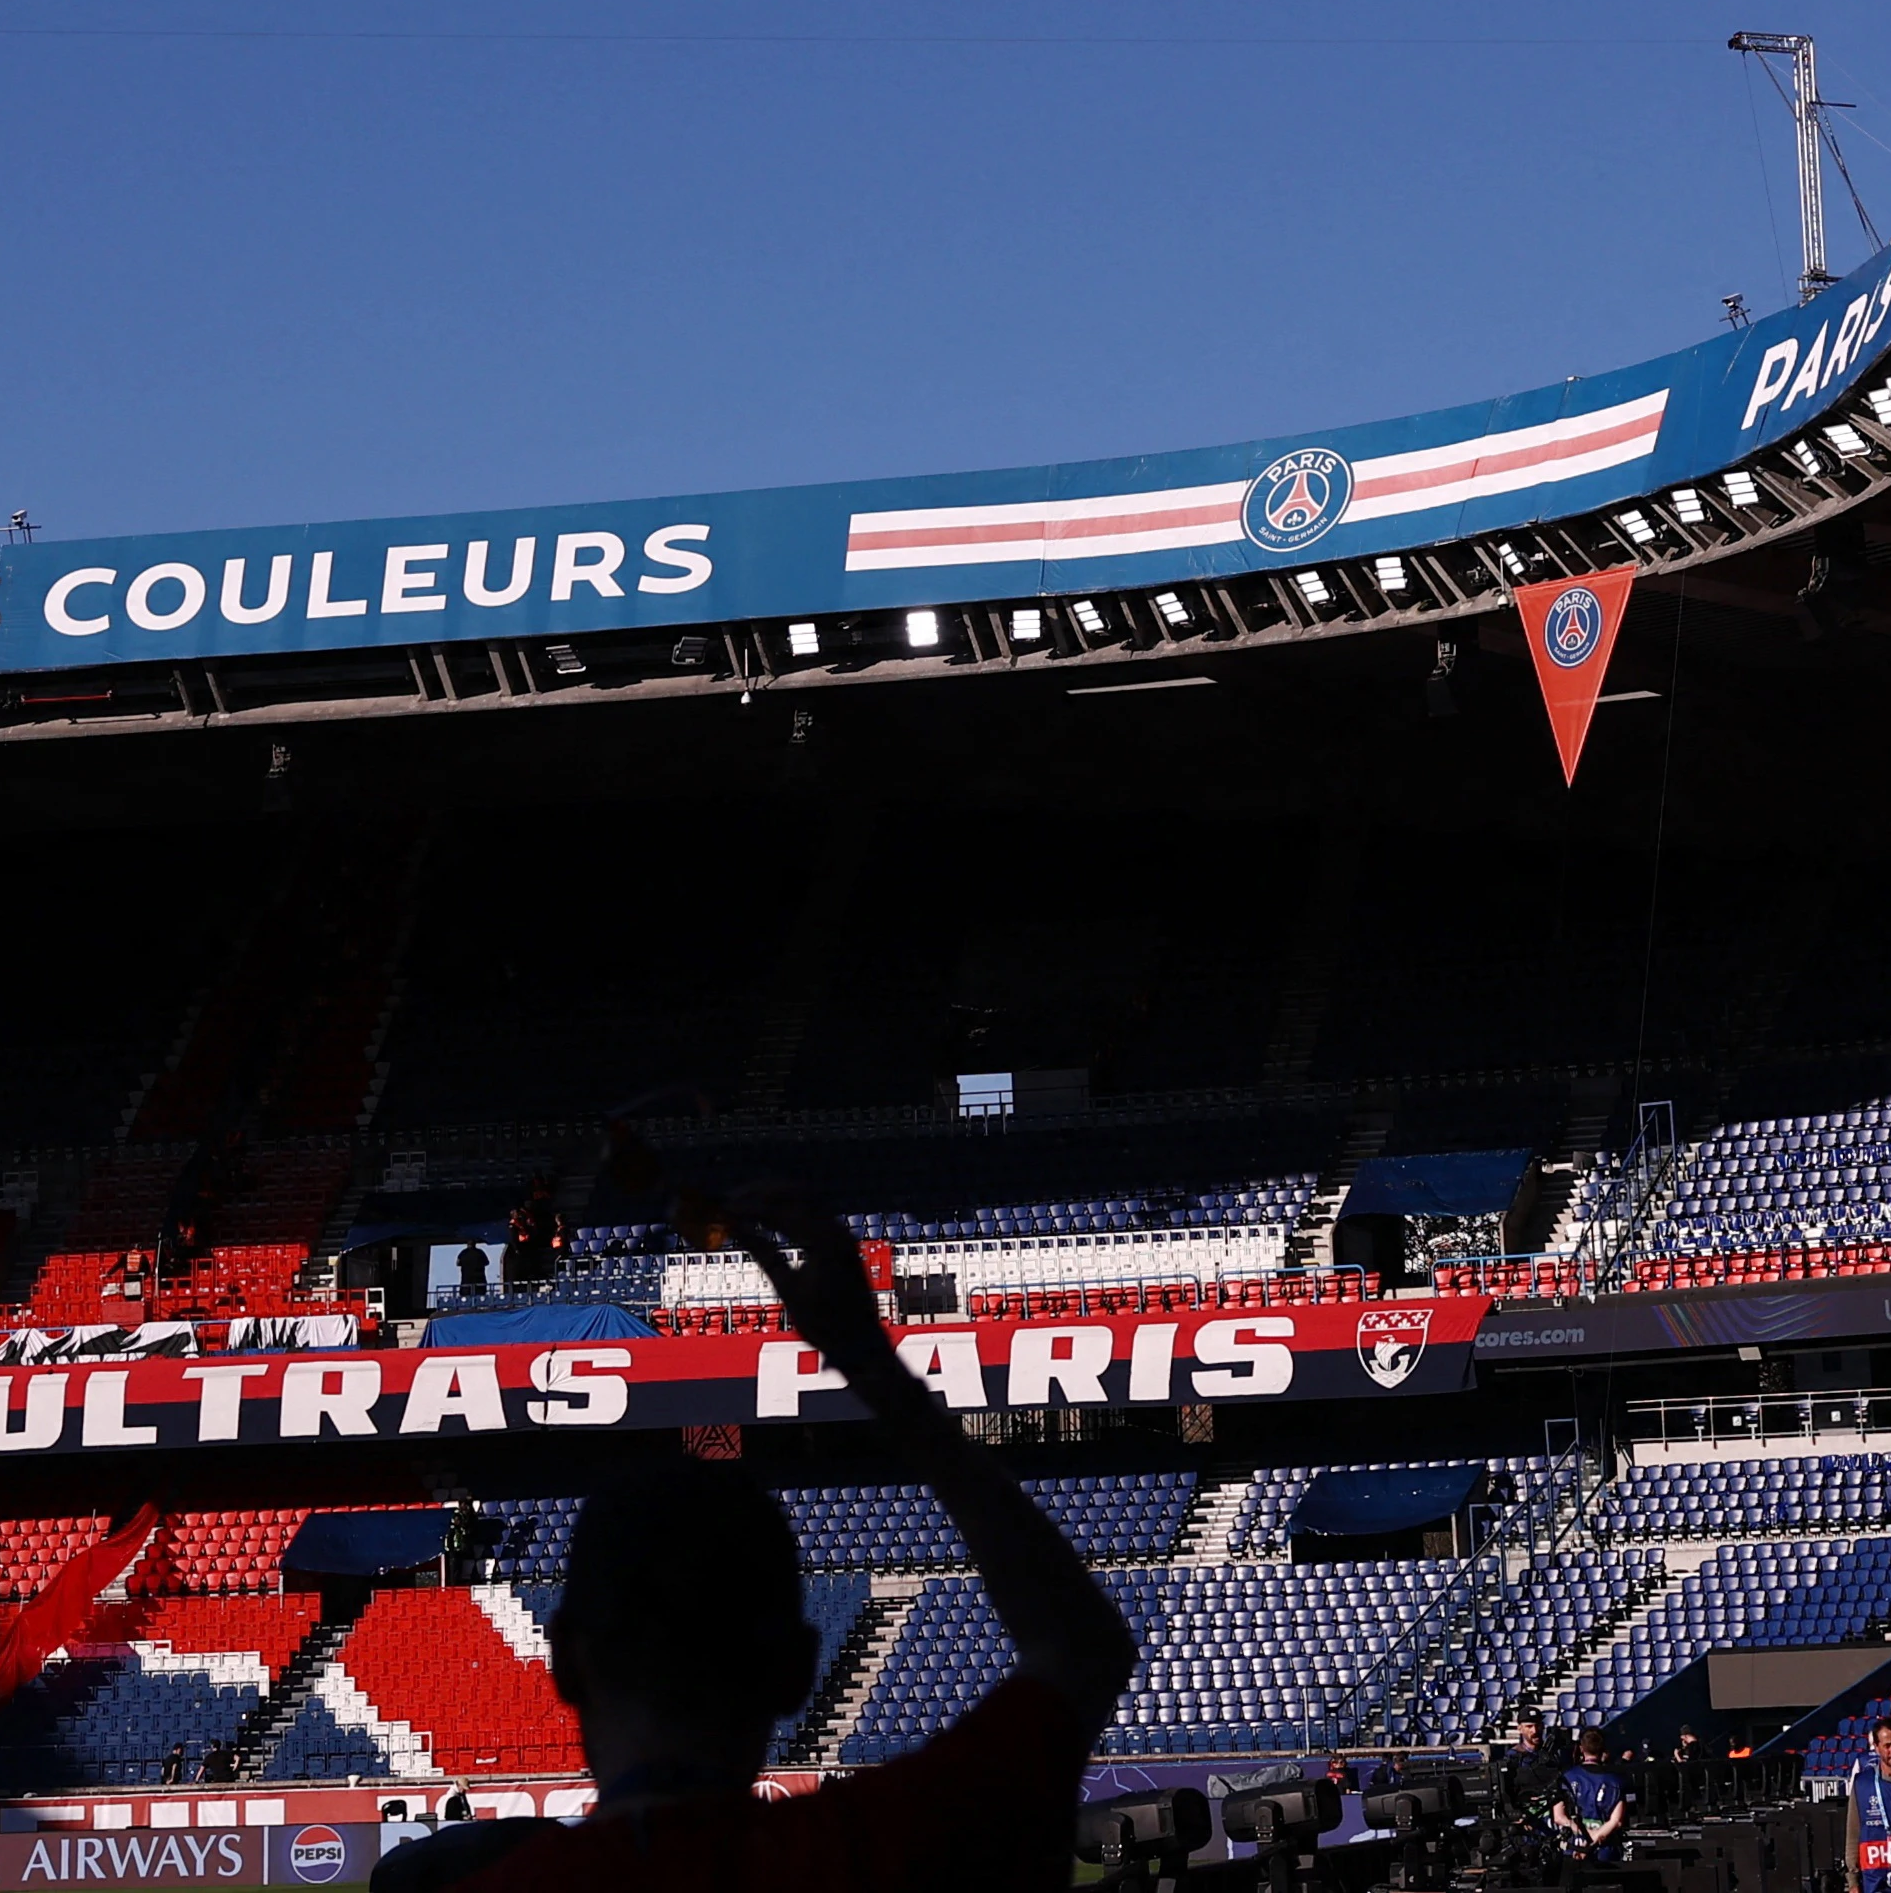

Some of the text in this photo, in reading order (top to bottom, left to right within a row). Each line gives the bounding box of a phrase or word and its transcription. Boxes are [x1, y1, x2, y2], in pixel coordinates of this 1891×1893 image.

[1267, 453, 1337, 483] PARIS
[44, 524, 713, 636] COULEURS
[1555, 592, 1593, 614] PARIS
[756, 1316, 1295, 1418] PARIS
[21, 1833, 244, 1882] AIRWAYS
[293, 1847, 342, 1861] PEPSI
